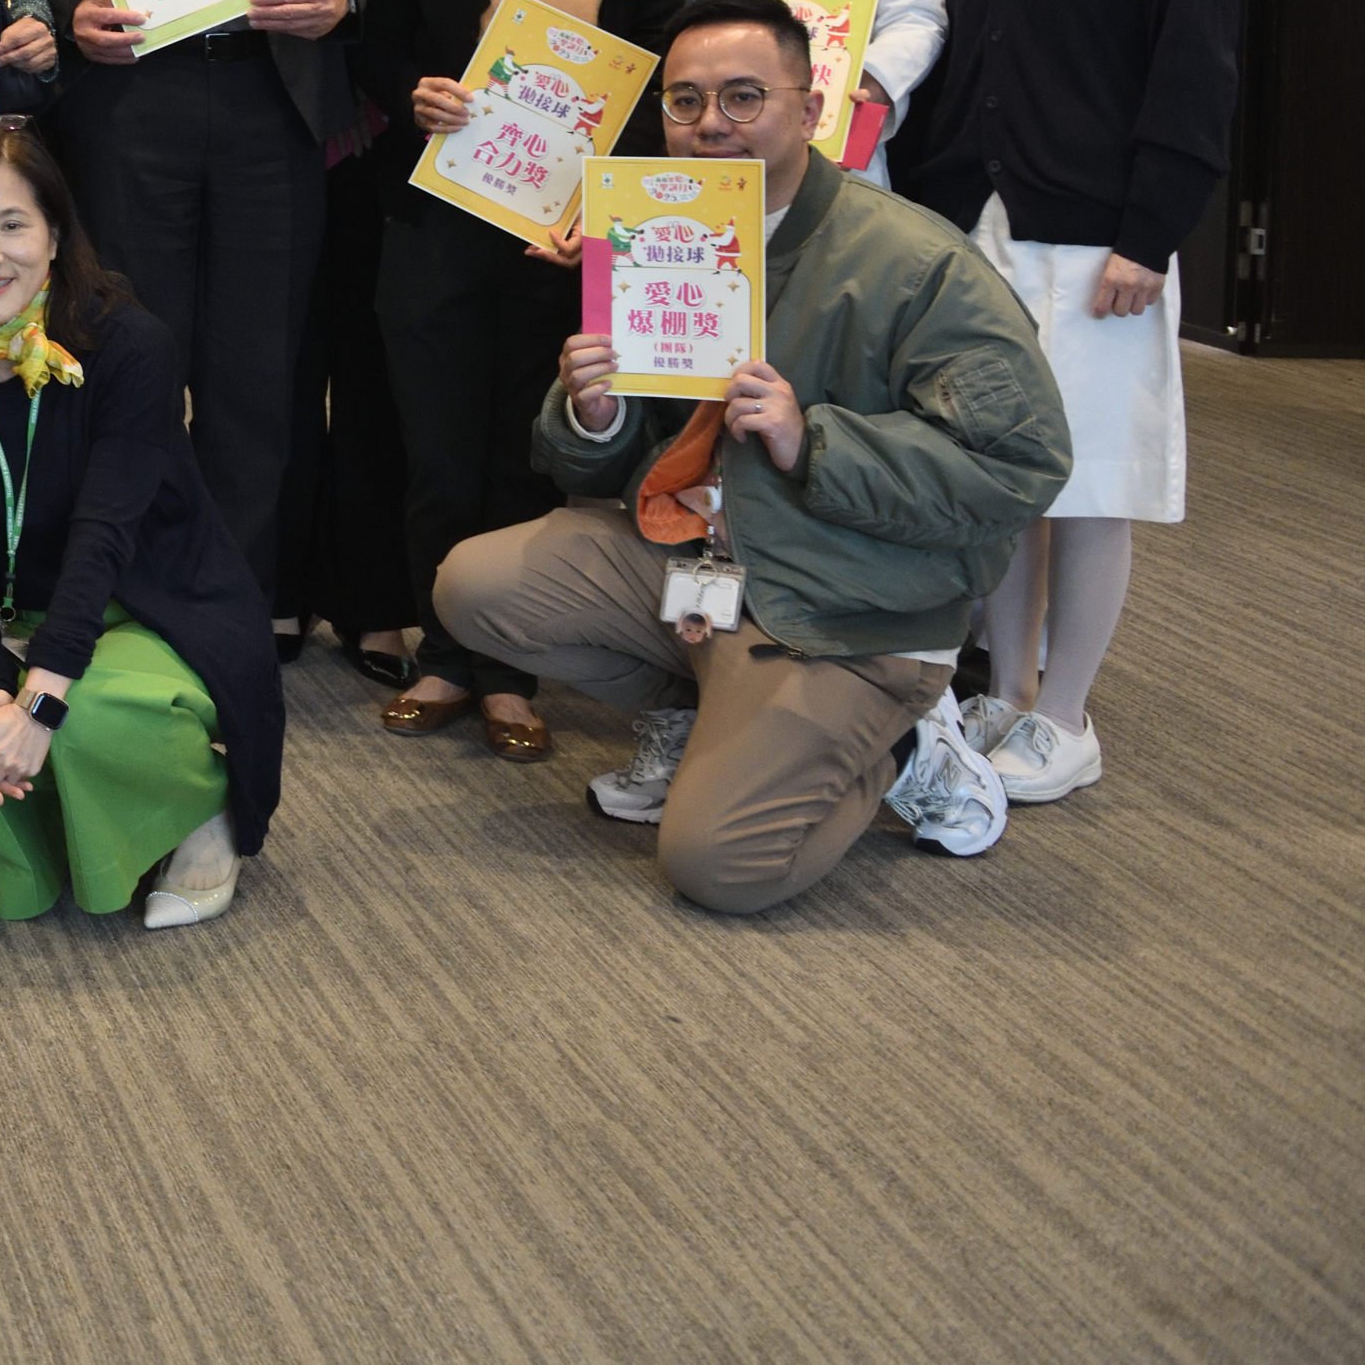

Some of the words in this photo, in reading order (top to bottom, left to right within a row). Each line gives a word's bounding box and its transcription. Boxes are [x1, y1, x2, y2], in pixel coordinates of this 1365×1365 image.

[535, 71, 570, 99] 愛心
[518, 85, 571, 119] 拋接球
[496, 123, 547, 158] 齊心
[473, 140, 549, 189] 合力獎
[652, 225, 695, 244] 愛心
[646, 246, 705, 264] 拋接球
[644, 281, 704, 307] 愛心
[627, 309, 720, 338] 爆棚獎
